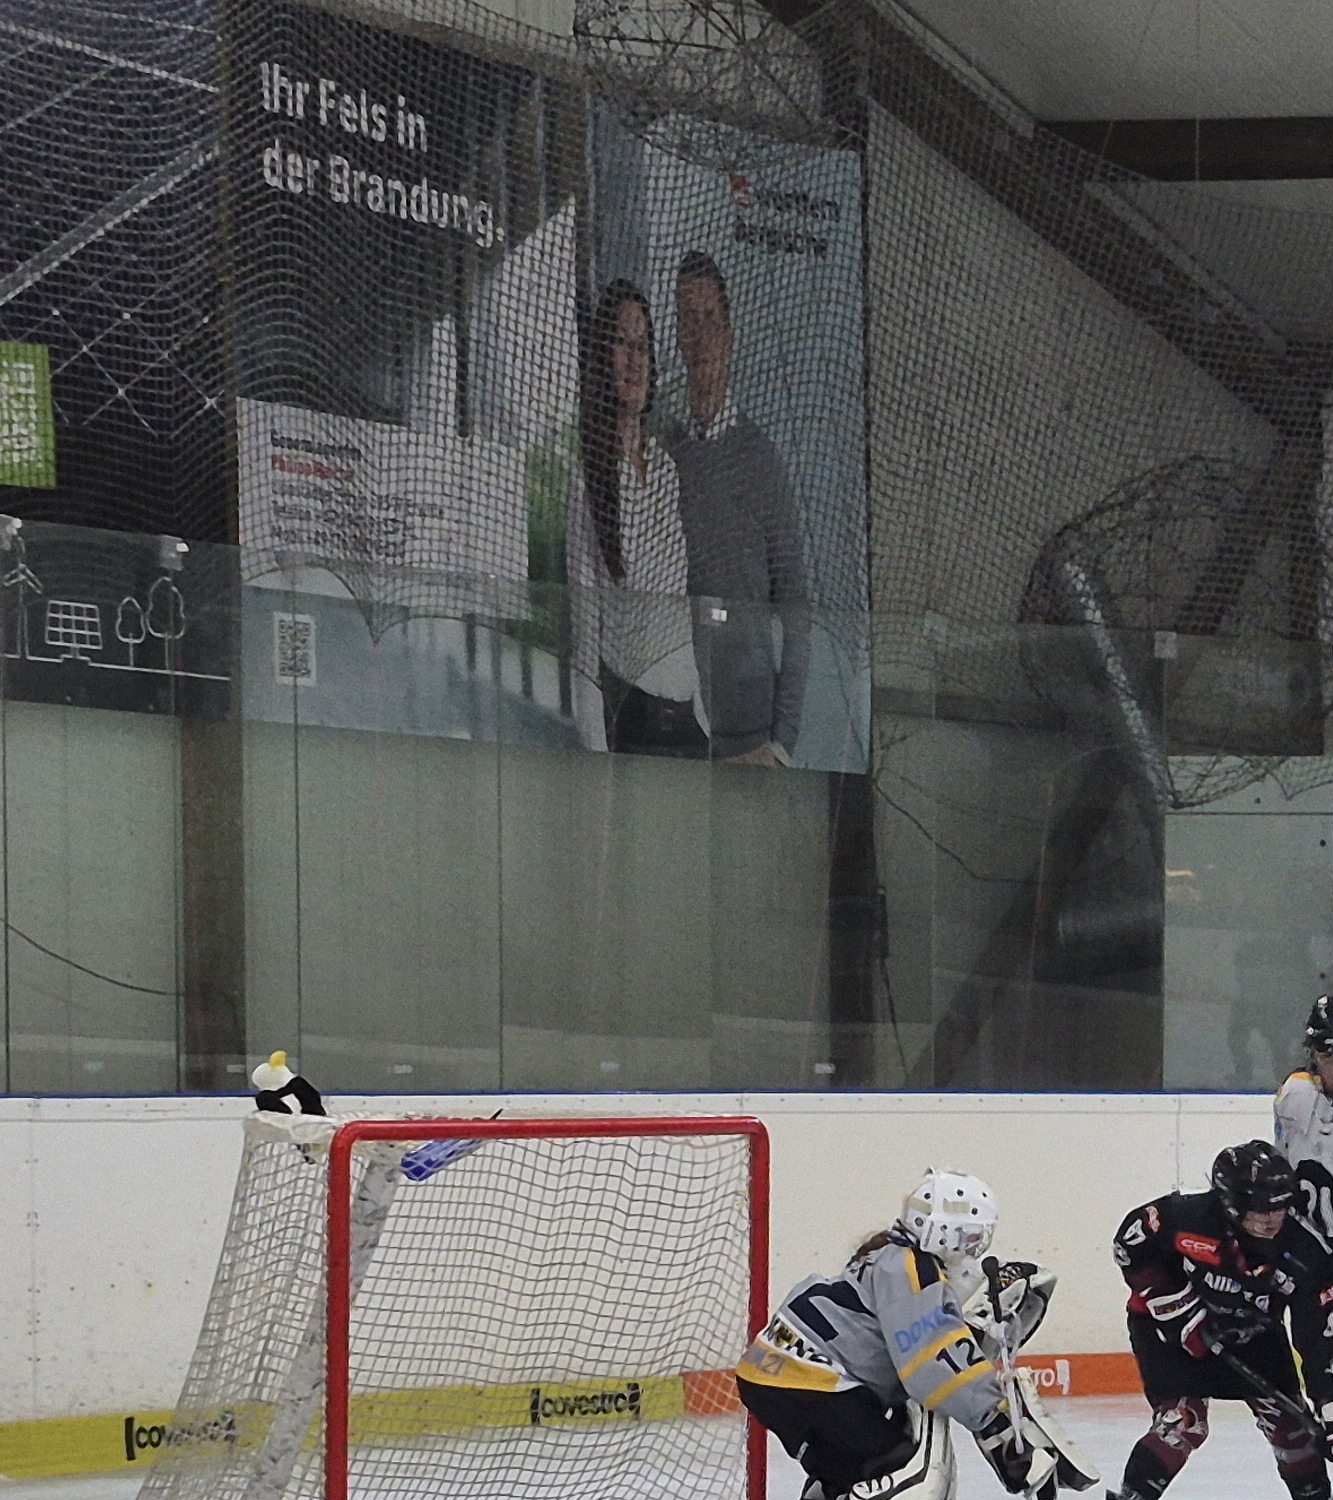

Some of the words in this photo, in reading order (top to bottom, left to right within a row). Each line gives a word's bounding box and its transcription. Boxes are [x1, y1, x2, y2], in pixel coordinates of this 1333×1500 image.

[260, 62, 310, 118] Ihr
[319, 78, 387, 142] Fels
[397, 94, 428, 152] in
[263, 138, 321, 195] der
[329, 155, 504, 248] Brandung.
[936, 1337, 987, 1375] 12
[541, 1392, 628, 1419] covestro
